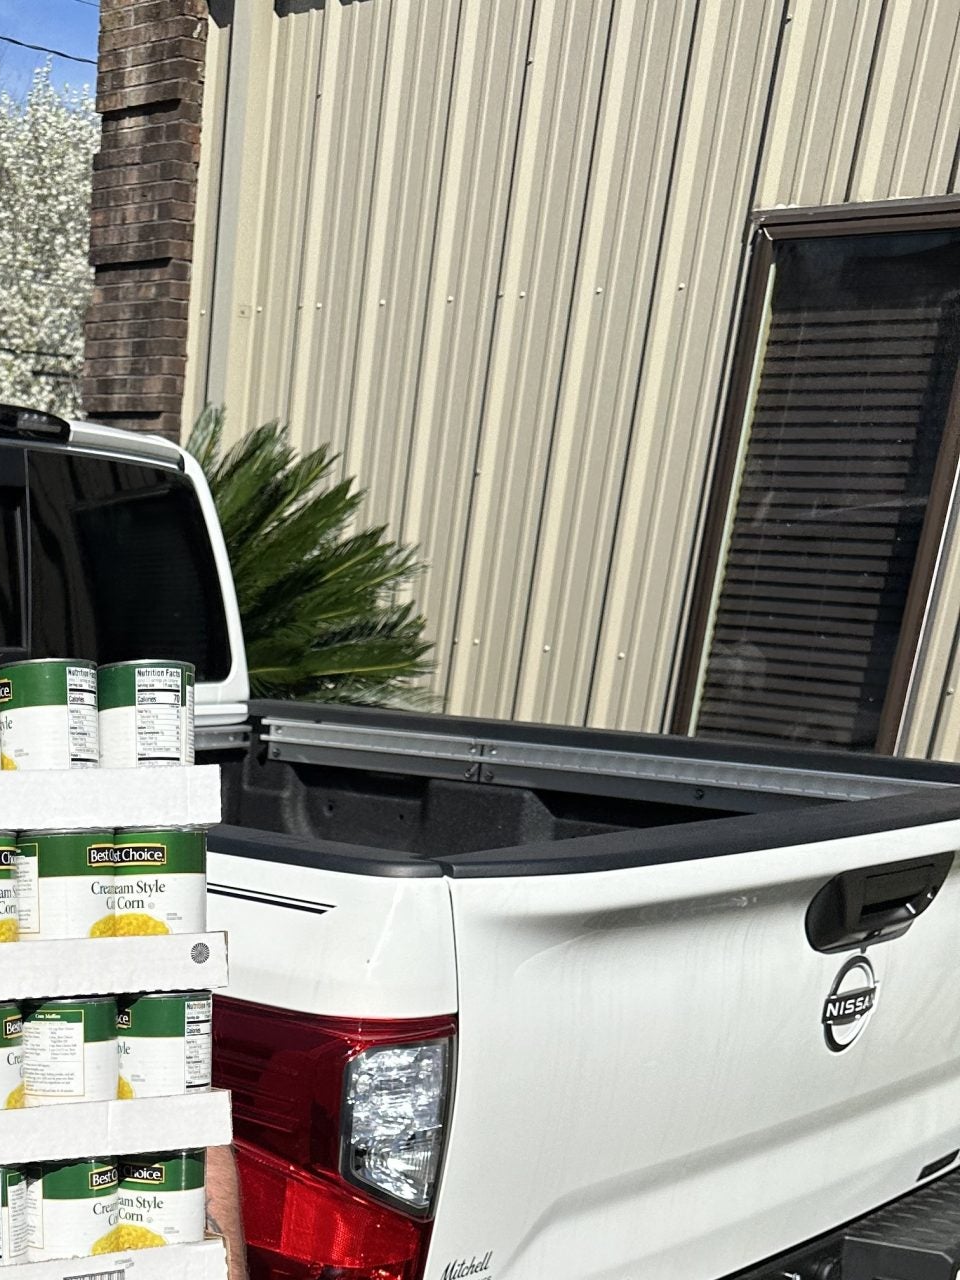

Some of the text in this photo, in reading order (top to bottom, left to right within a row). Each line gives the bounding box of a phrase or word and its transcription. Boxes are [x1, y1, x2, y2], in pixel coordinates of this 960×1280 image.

[137, 668, 181, 678] Nutrition Facts
[173, 693, 180, 704] 70
[90, 849, 109, 863] Best
[136, 879, 166, 898] Style
[117, 896, 145, 910] Corn
[92, 1171, 111, 1186] Best
[135, 1196, 165, 1213] Style
[118, 1207, 144, 1222] Corn
